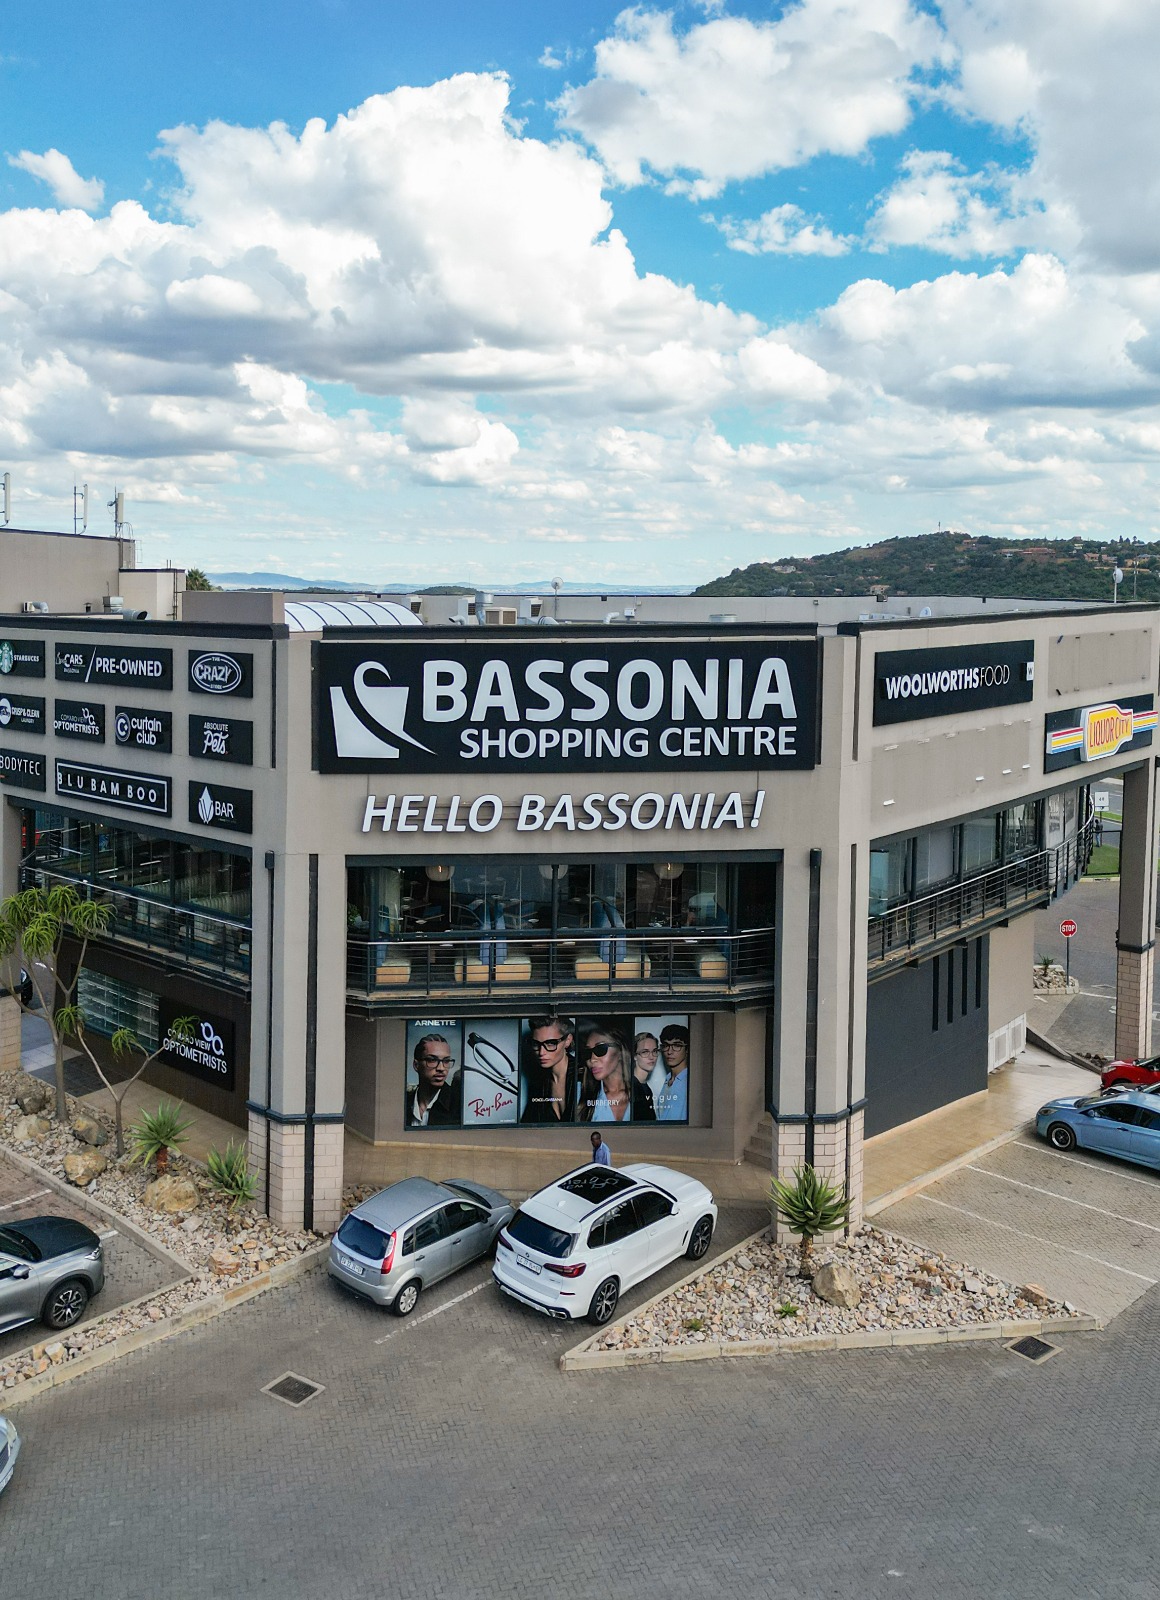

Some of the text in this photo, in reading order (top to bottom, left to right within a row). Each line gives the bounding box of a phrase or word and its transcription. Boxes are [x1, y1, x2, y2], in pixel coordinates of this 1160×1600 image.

[13, 654, 40, 662] STARBUCKS
[95, 657, 163, 677] PRE-OWNED
[194, 664, 232, 683] CRAZY
[422, 657, 798, 723] BASSONIA
[53, 720, 100, 736] OPTOMETRISTS
[131, 716, 162, 733] curtain
[203, 721, 229, 732] ABSOLUTE
[1089, 716, 1129, 748] LIQUOR CITY
[136, 732, 157, 746] club
[202, 730, 230, 755] Pets
[459, 726, 798, 759] SHOPPING CENTRE
[0, 754, 41, 776] BODYTEC
[214, 800, 234, 819] BAR
[362, 790, 767, 833] HELLO BASSONIA!
[1061, 924, 1076, 933] STOP
[414, 1019, 456, 1027] ARNETTE
[195, 1037, 210, 1051] VIEW
[162, 1037, 228, 1074] OPTOMETRISTS
[467, 1091, 514, 1118] Ray-Ban
[586, 1099, 621, 1107] BURBERRY
[645, 1094, 678, 1103] vogue
